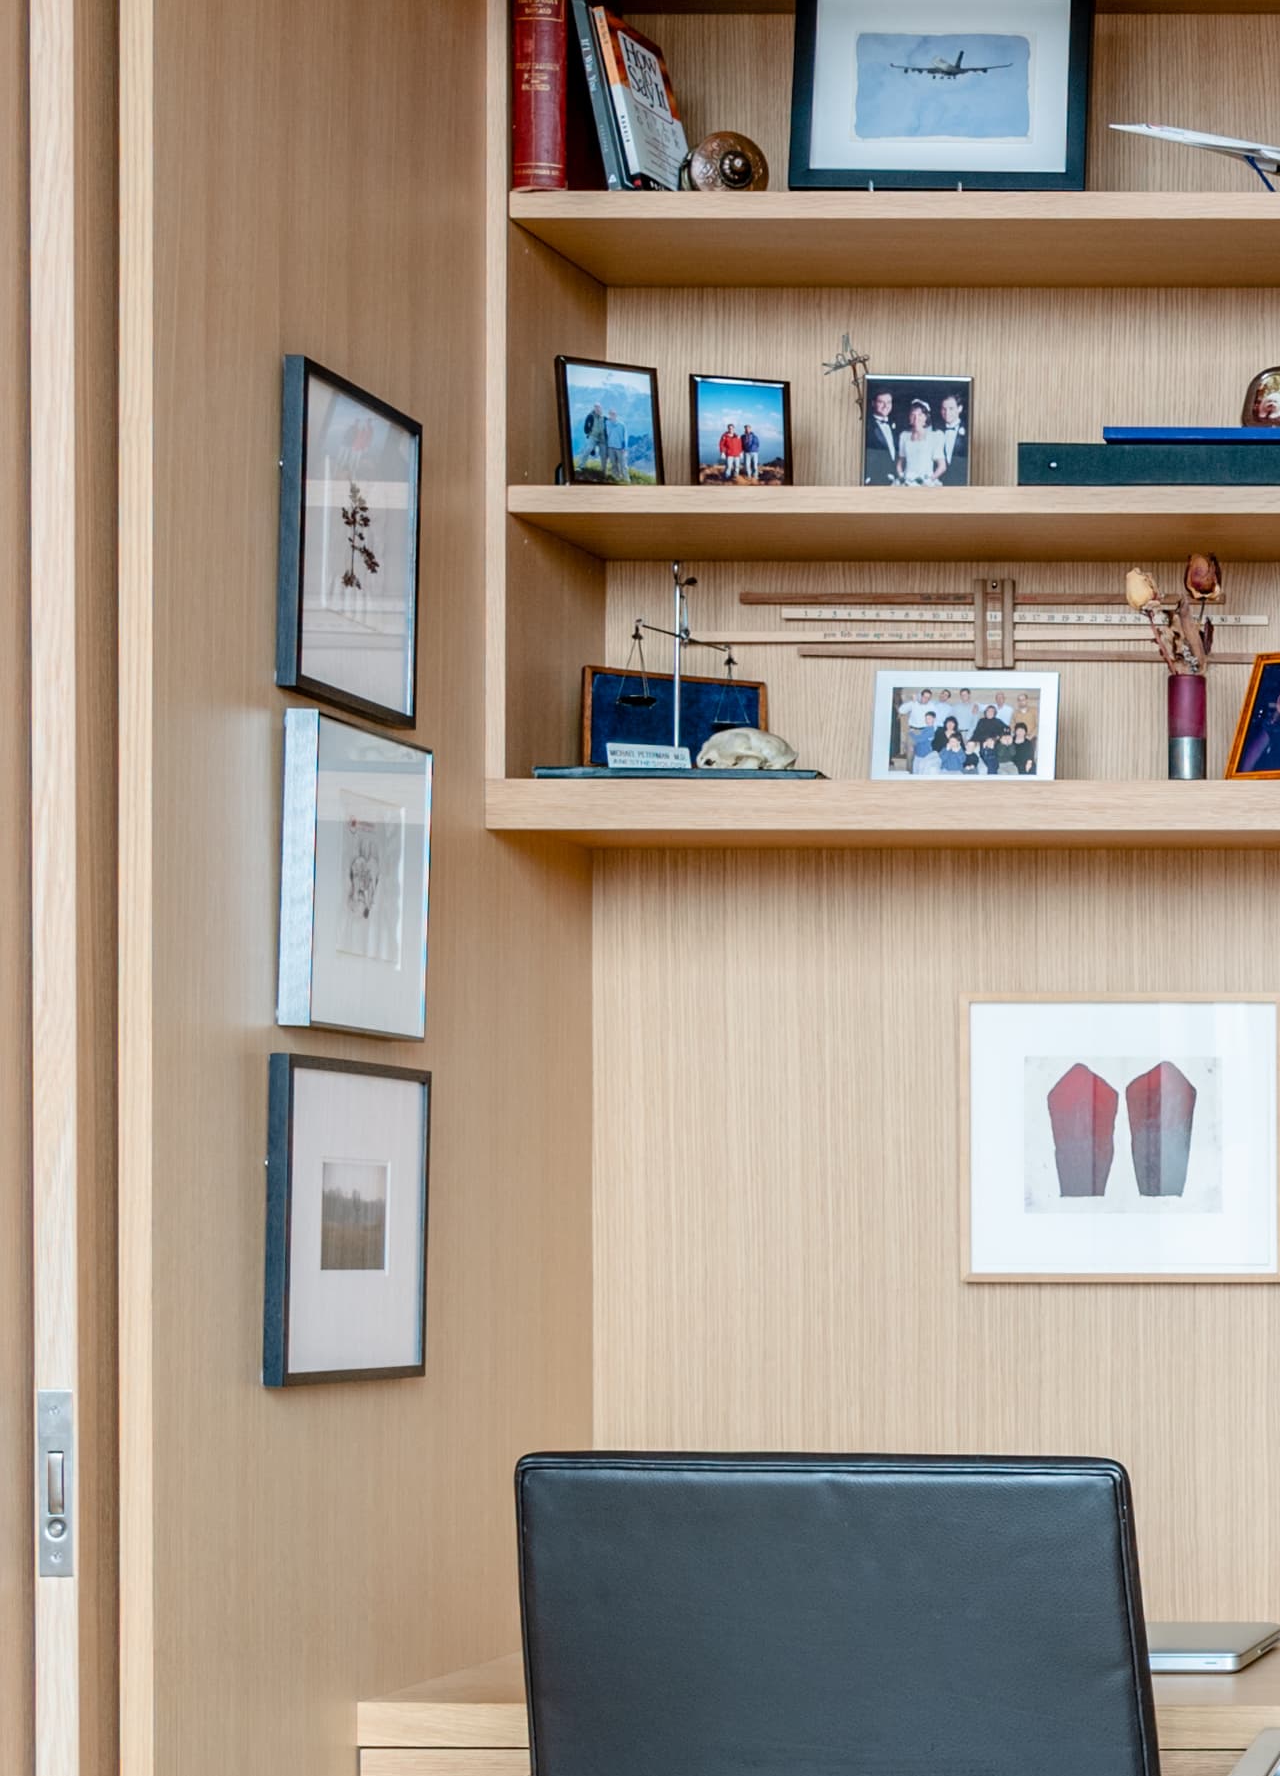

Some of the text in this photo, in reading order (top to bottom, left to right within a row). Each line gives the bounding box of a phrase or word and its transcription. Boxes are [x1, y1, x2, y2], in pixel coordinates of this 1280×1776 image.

[621, 34, 657, 76] How
[628, 65, 669, 111] Say It
